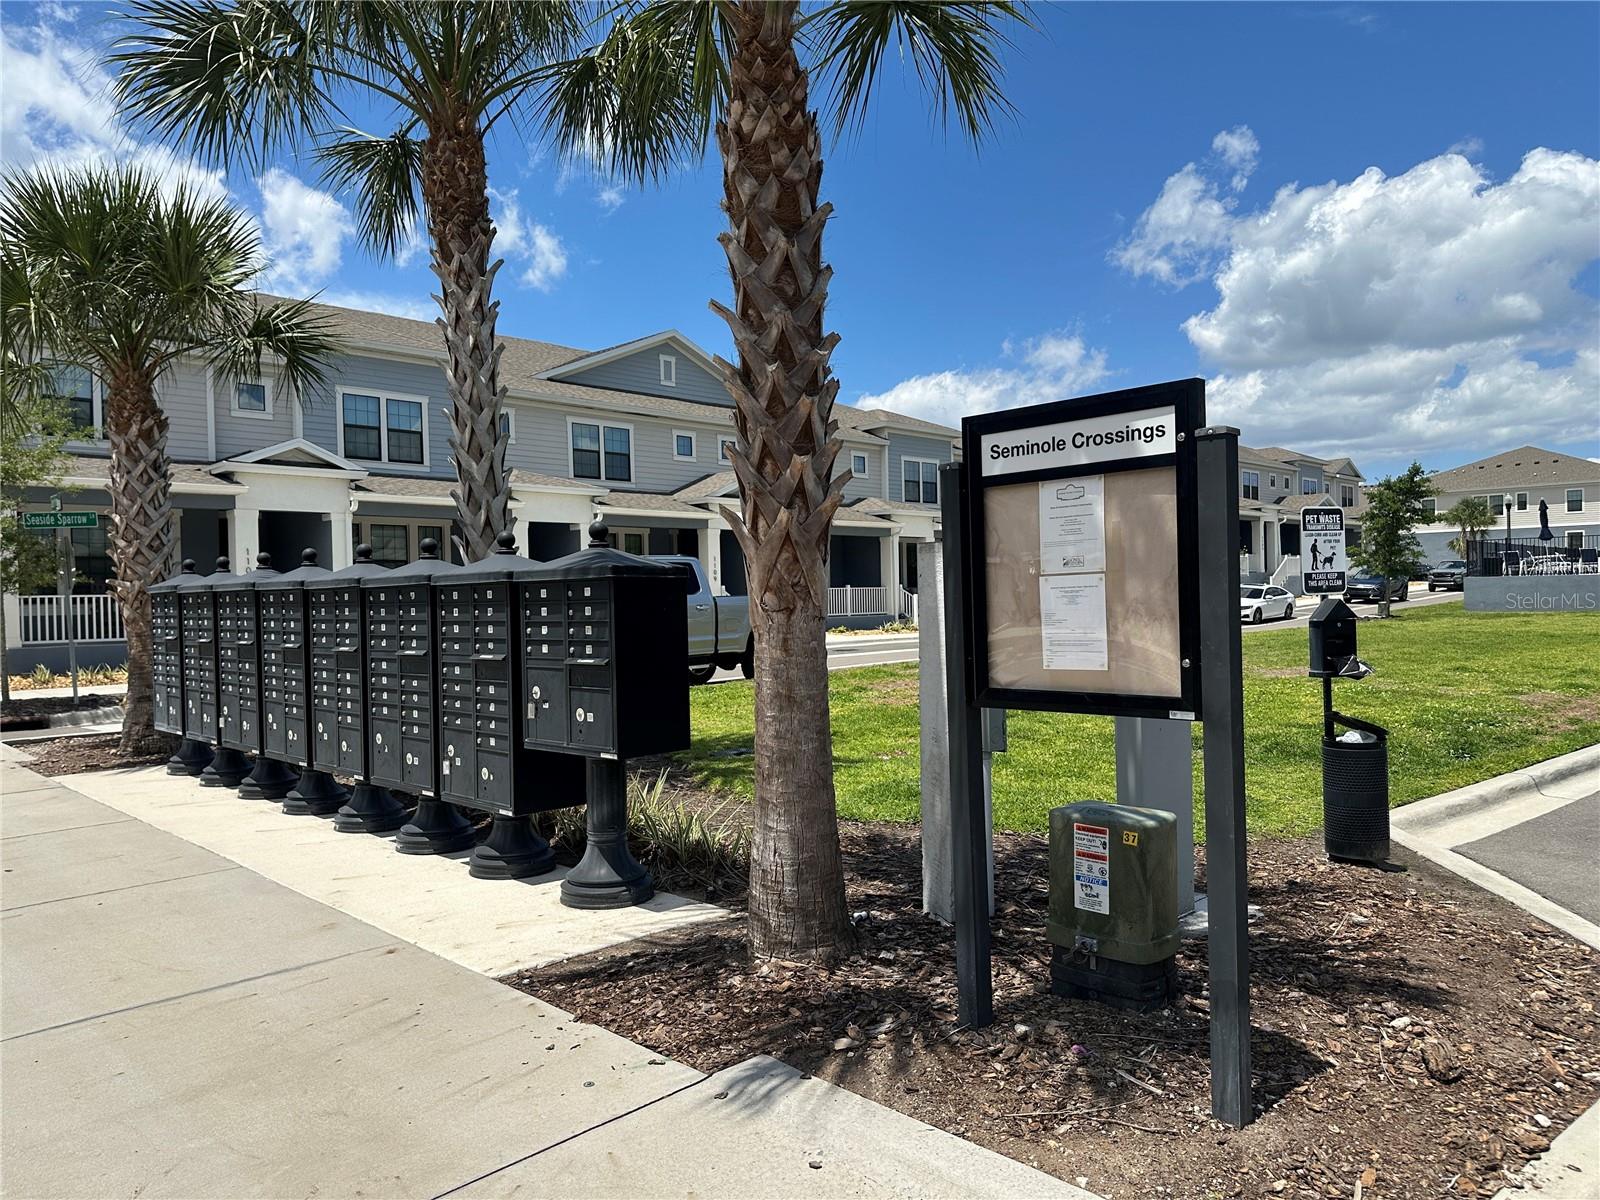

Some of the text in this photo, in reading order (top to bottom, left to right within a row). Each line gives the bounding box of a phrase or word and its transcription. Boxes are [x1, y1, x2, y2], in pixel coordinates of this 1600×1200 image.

[990, 424, 1166, 460] Seminole Crossings
[26, 513, 55, 526] Seaside
[57, 513, 87, 526] Sparrow
[1305, 514, 1341, 524] PET WASTE
[1124, 833, 1137, 843] 37
[1079, 876, 1102, 885] NOTICE
